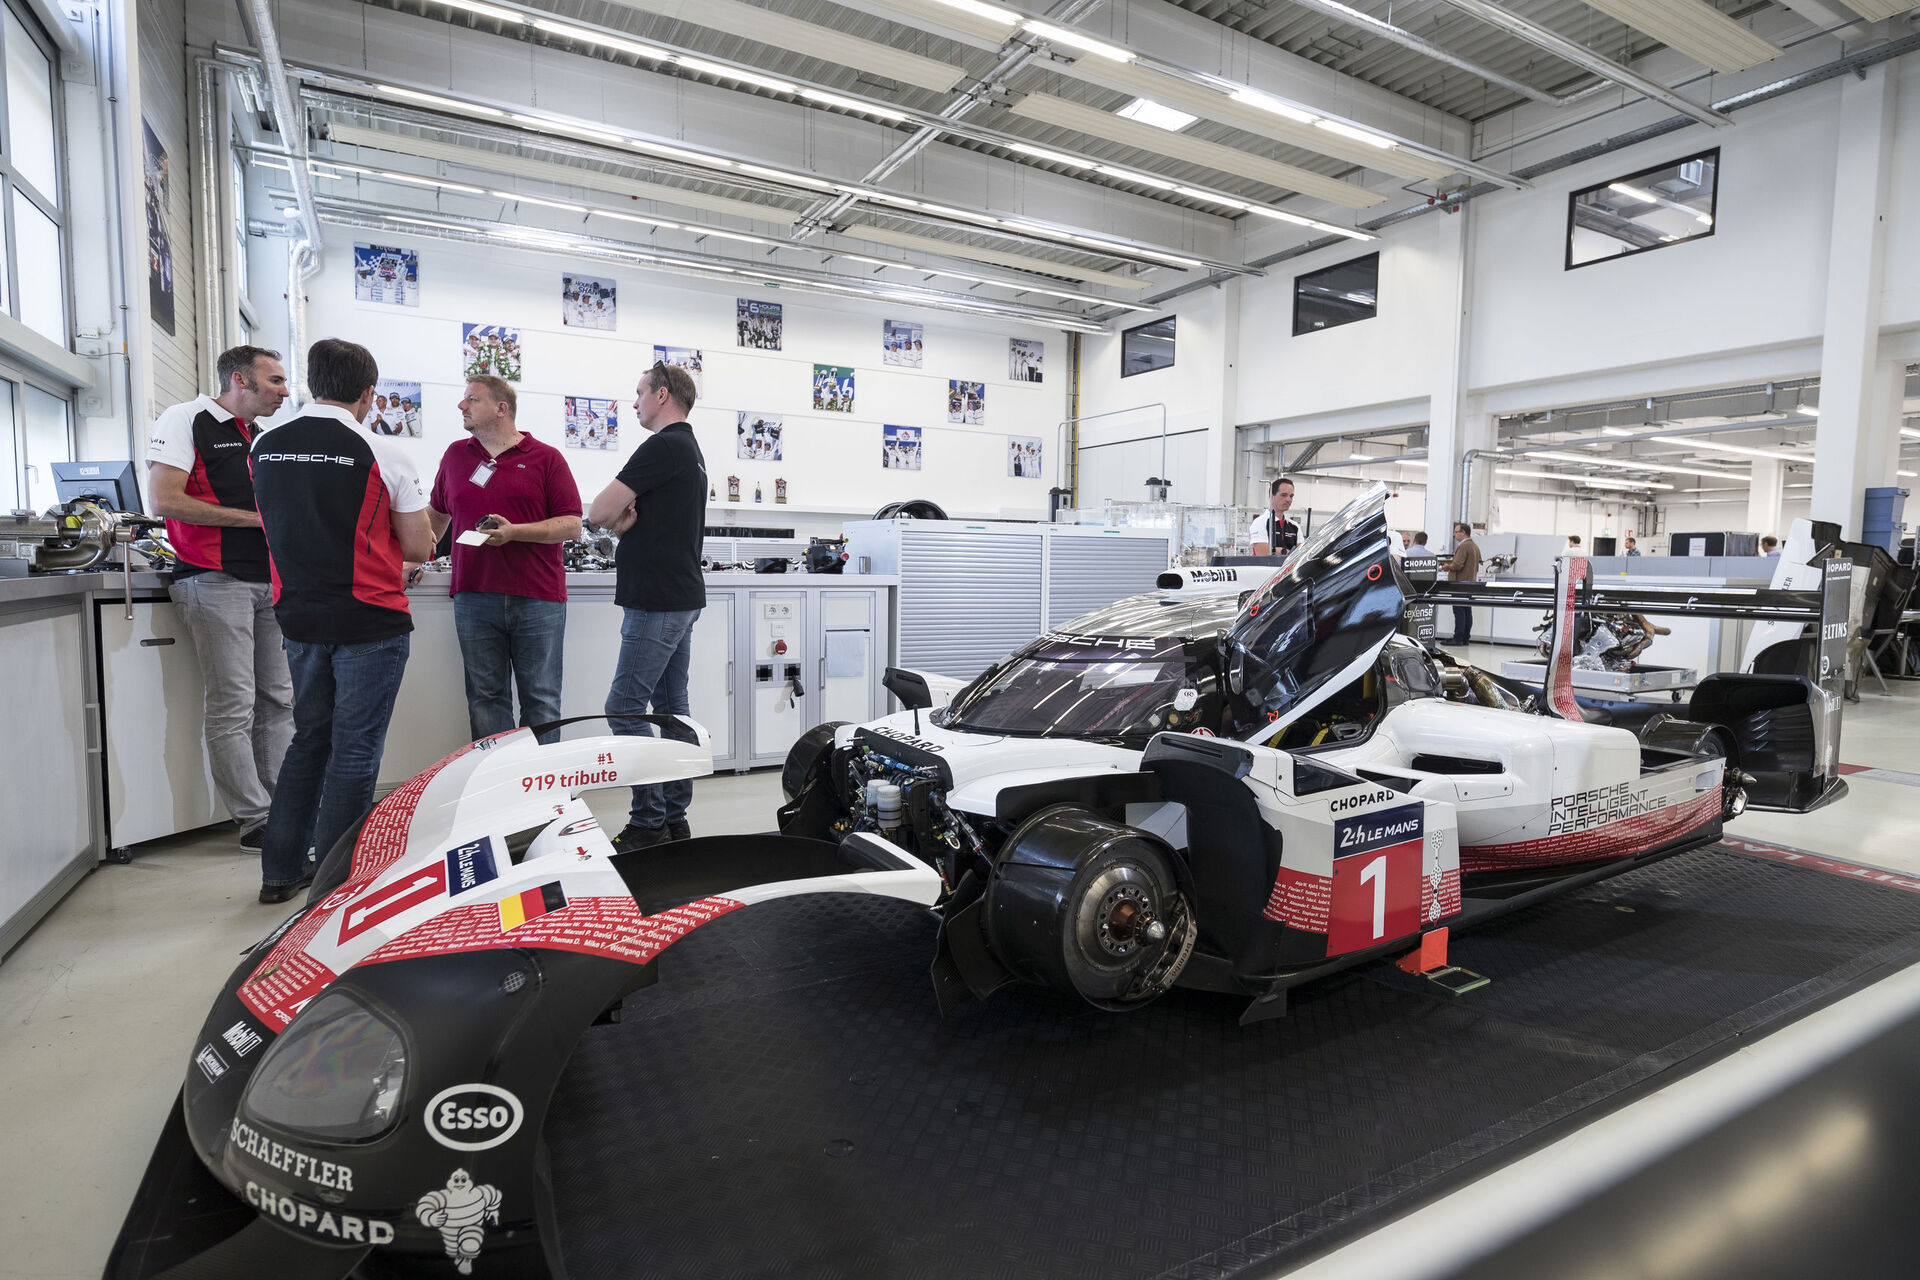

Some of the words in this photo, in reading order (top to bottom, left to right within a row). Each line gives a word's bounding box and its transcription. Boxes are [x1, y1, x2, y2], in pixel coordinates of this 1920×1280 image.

[750, 303, 760, 313] 6
[258, 453, 355, 466] PORSCHE
[1404, 560, 1437, 568] CHOPARD
[1826, 562, 1851, 573] HOPARD
[1190, 571, 1225, 583] Mobil
[1824, 622, 1848, 640] ELTINS
[873, 726, 945, 753] CHOPARD
[598, 752, 615, 766] #1
[522, 774, 556, 793] 919
[560, 769, 618, 788] tribute
[1330, 790, 1395, 812] CHOPARD
[1549, 789, 1649, 824] INTELLIGENT
[1552, 782, 1630, 811] PORSCHE
[1547, 796, 1667, 836] PERFORMANCE
[1367, 828, 1382, 841] LE
[1384, 819, 1419, 837] MANS
[348, 876, 438, 930] 1
[688, 902, 713, 911] Markus
[1360, 855, 1387, 940] 1
[632, 918, 653, 927] Walter
[683, 909, 705, 919] Santos
[593, 930, 612, 939] David
[622, 935, 654, 949] Christoph
[616, 925, 637, 934] Martin
[584, 940, 601, 948] Mike
[610, 944, 641, 958] Wolfgang
[1171, 942, 1194, 978] brembo
[222, 1020, 256, 1051] Mobil
[230, 1116, 354, 1192] SCHAEFFLER
[246, 1181, 395, 1244] CHOPARD
